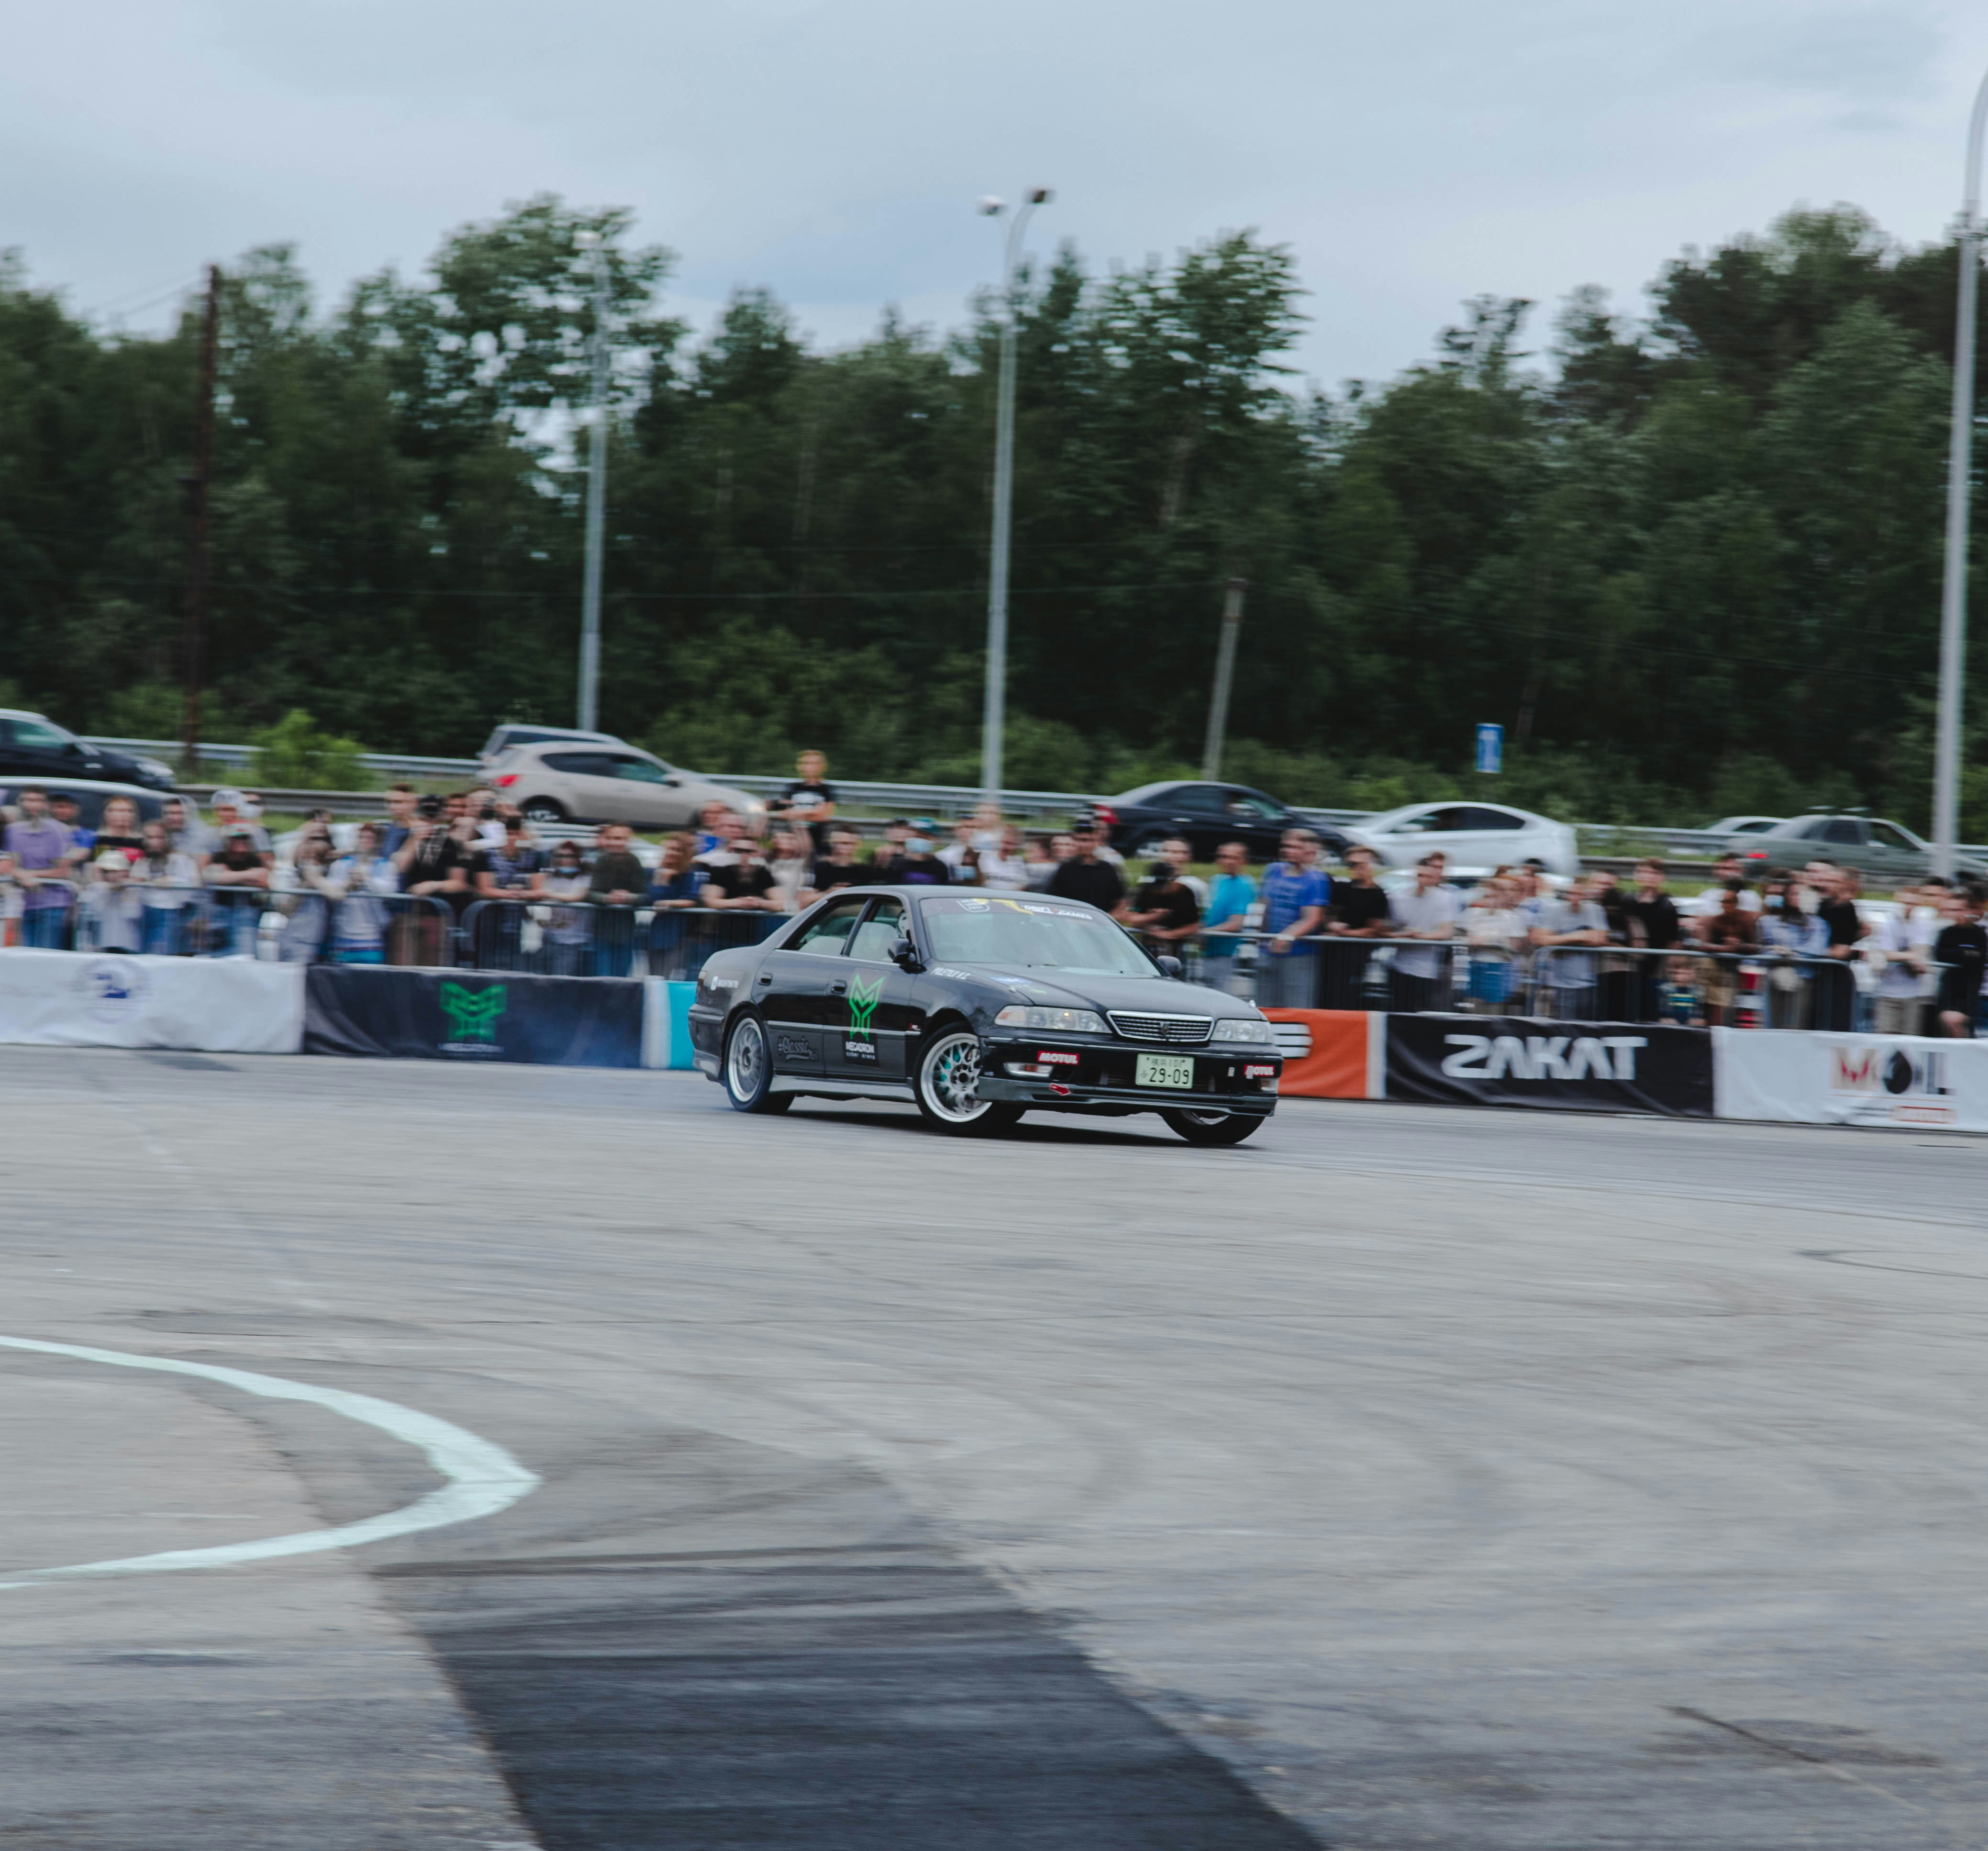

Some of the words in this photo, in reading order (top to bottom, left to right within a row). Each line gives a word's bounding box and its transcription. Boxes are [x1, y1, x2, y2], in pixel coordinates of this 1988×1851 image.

[1039, 1053, 1077, 1064] MOTUL
[1441, 1034, 1648, 1080] ZAKAT
[1149, 1067, 1189, 1084] 29-09
